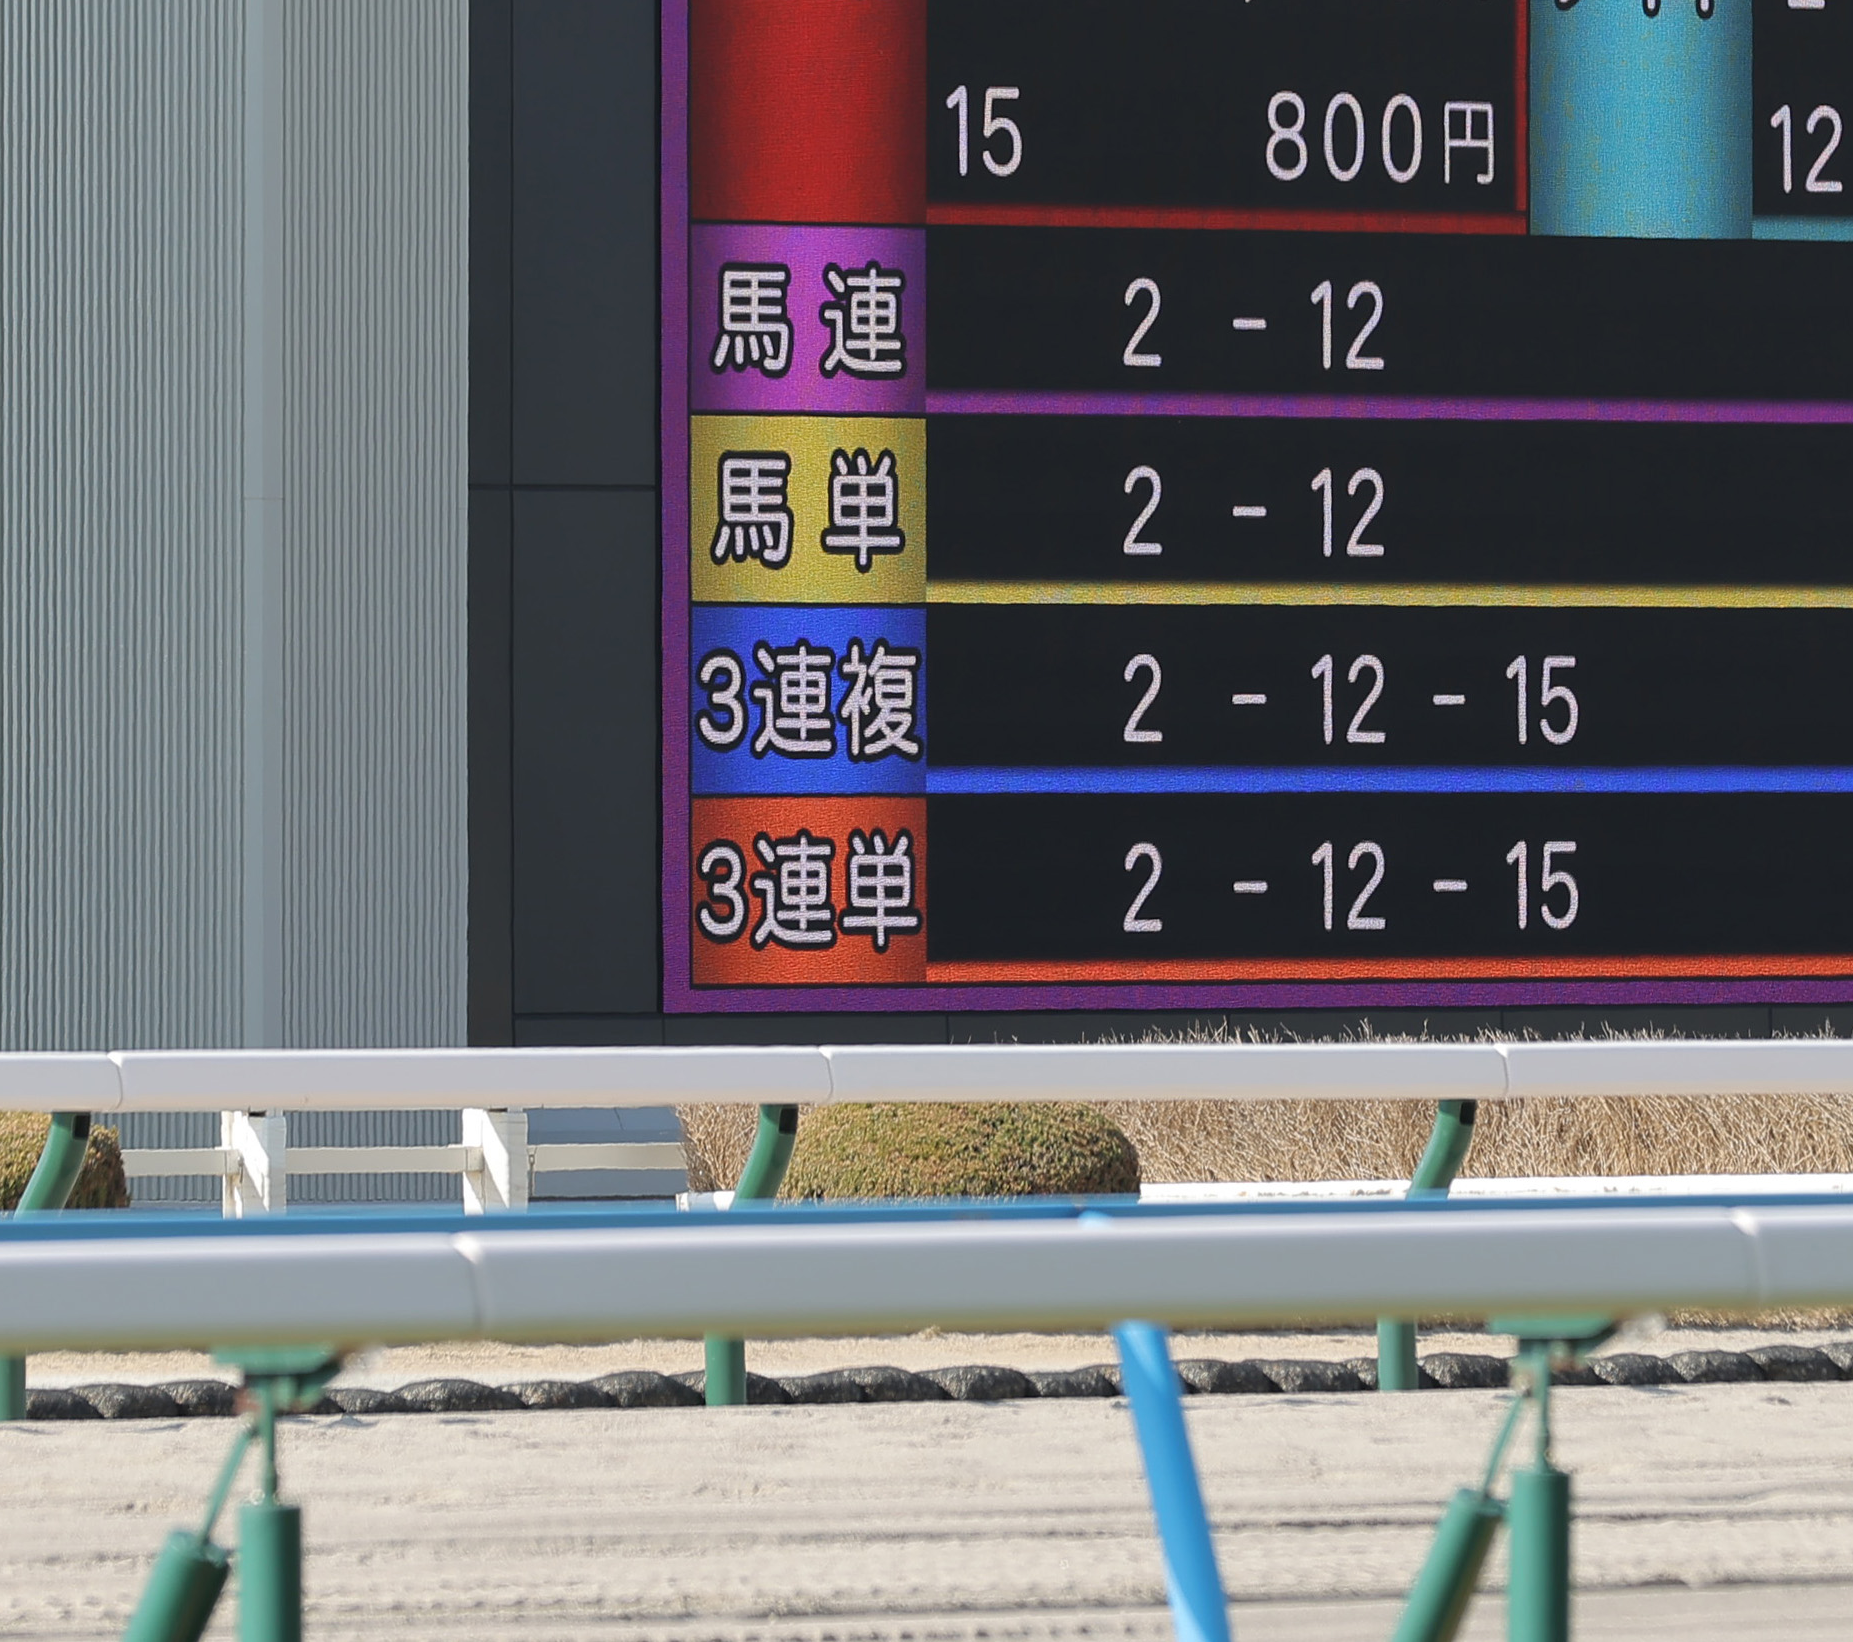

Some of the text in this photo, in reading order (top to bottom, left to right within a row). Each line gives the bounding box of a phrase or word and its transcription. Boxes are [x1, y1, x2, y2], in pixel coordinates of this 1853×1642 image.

[947, 86, 1493, 183] 15 800円
[1771, 105, 1842, 192] 12
[715, 269, 901, 371] 馬連
[1124, 279, 1161, 366] 2
[1312, 281, 1384, 369] 12
[716, 456, 899, 564] 馬単
[1124, 466, 1161, 553] 2
[1312, 469, 1384, 556] 12
[700, 646, 918, 754] 3連複
[1124, 655, 1162, 742] 2
[1312, 655, 1385, 743] 12
[1507, 656, 1577, 743] 15
[701, 836, 917, 945] 3連単
[1124, 844, 1161, 931] 2
[1312, 842, 1385, 929] 12
[1507, 842, 1578, 928] 15
